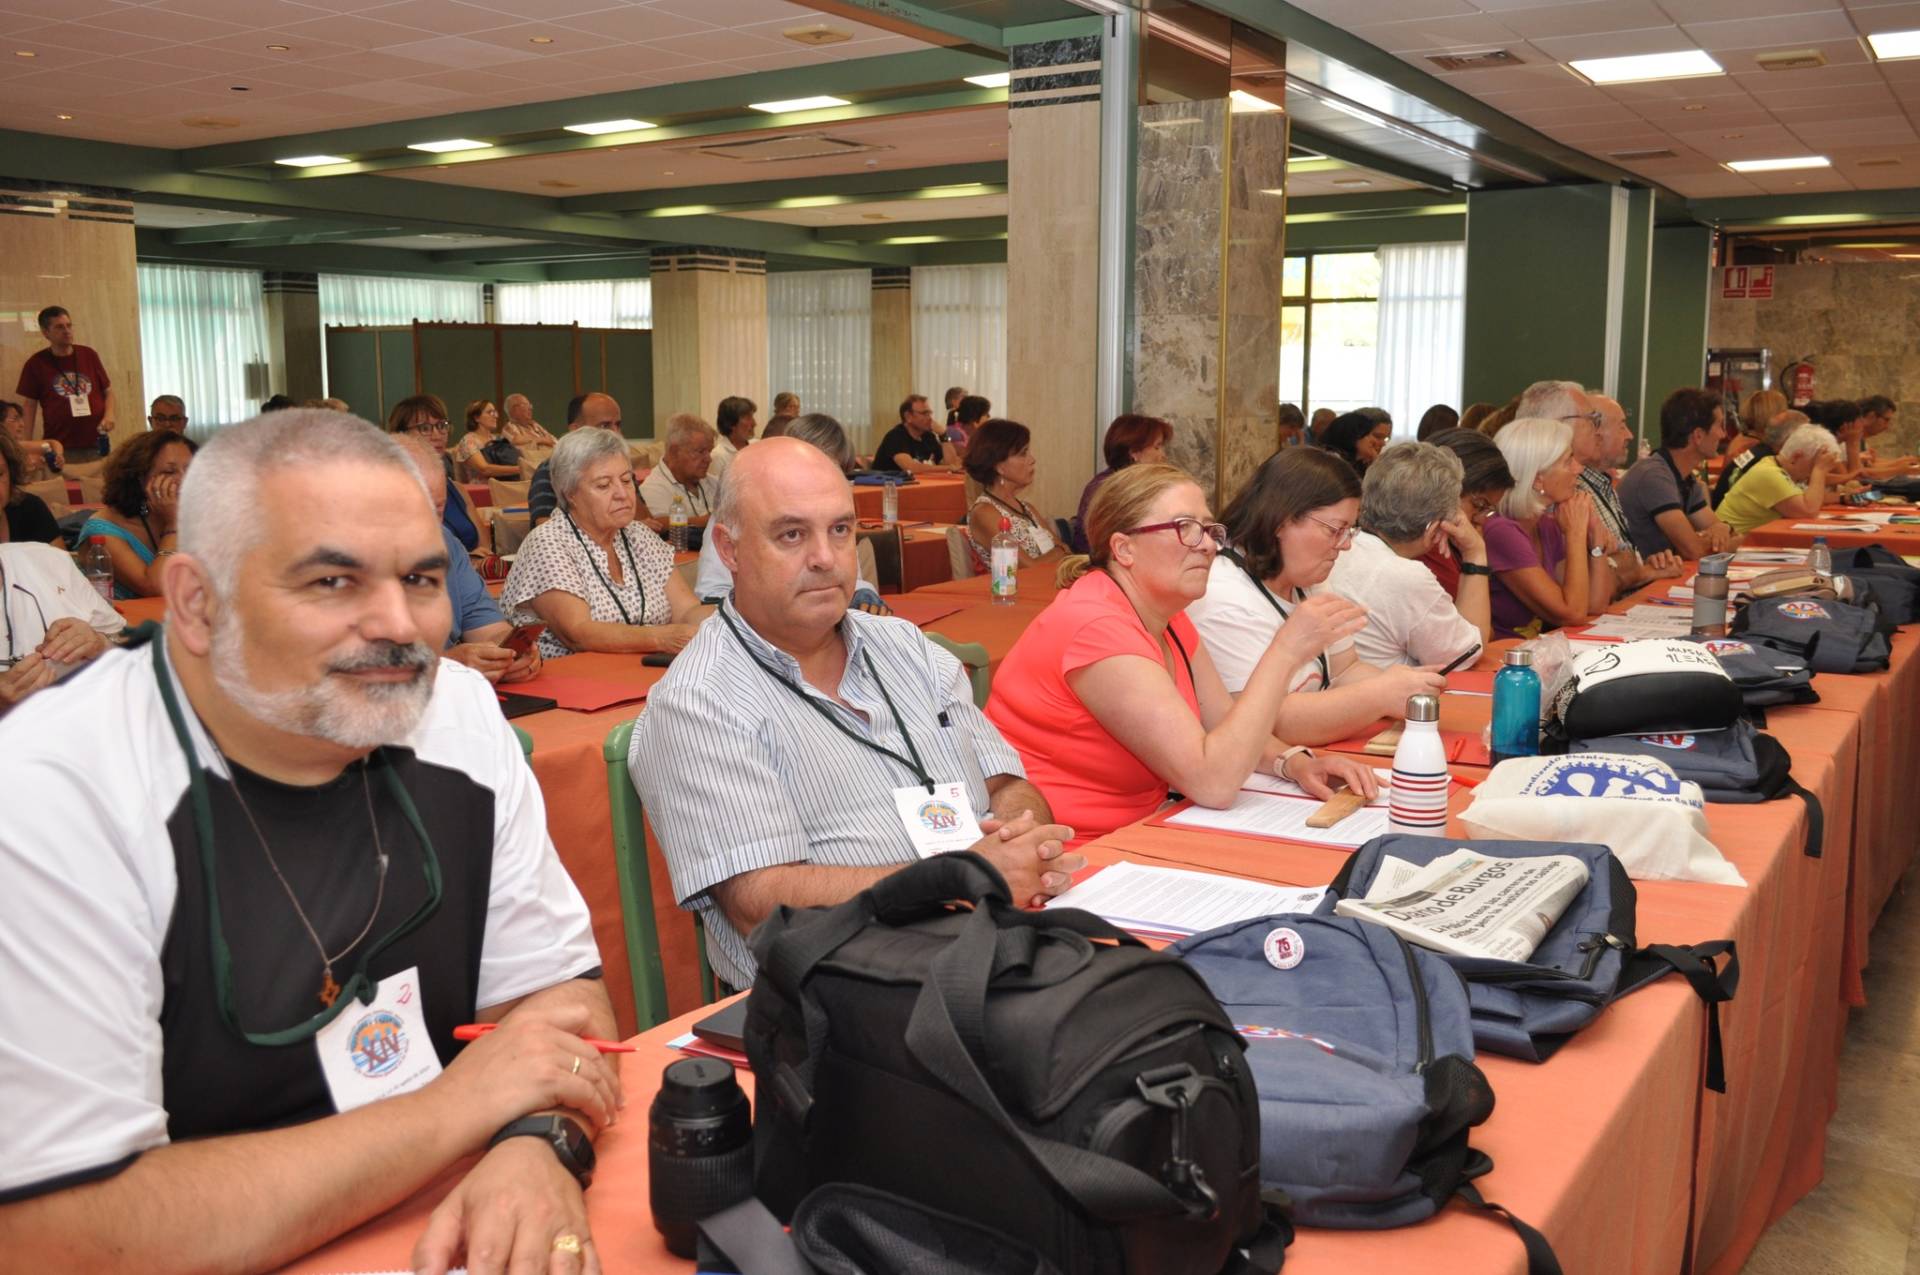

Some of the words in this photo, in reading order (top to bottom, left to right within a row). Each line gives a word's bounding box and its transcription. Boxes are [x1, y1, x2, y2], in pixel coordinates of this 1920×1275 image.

[949, 787, 960, 799] 5
[928, 814, 957, 830] XIV
[1430, 894, 1465, 908] de
[1448, 861, 1513, 894] Burgos
[362, 1032, 400, 1072] XIV
